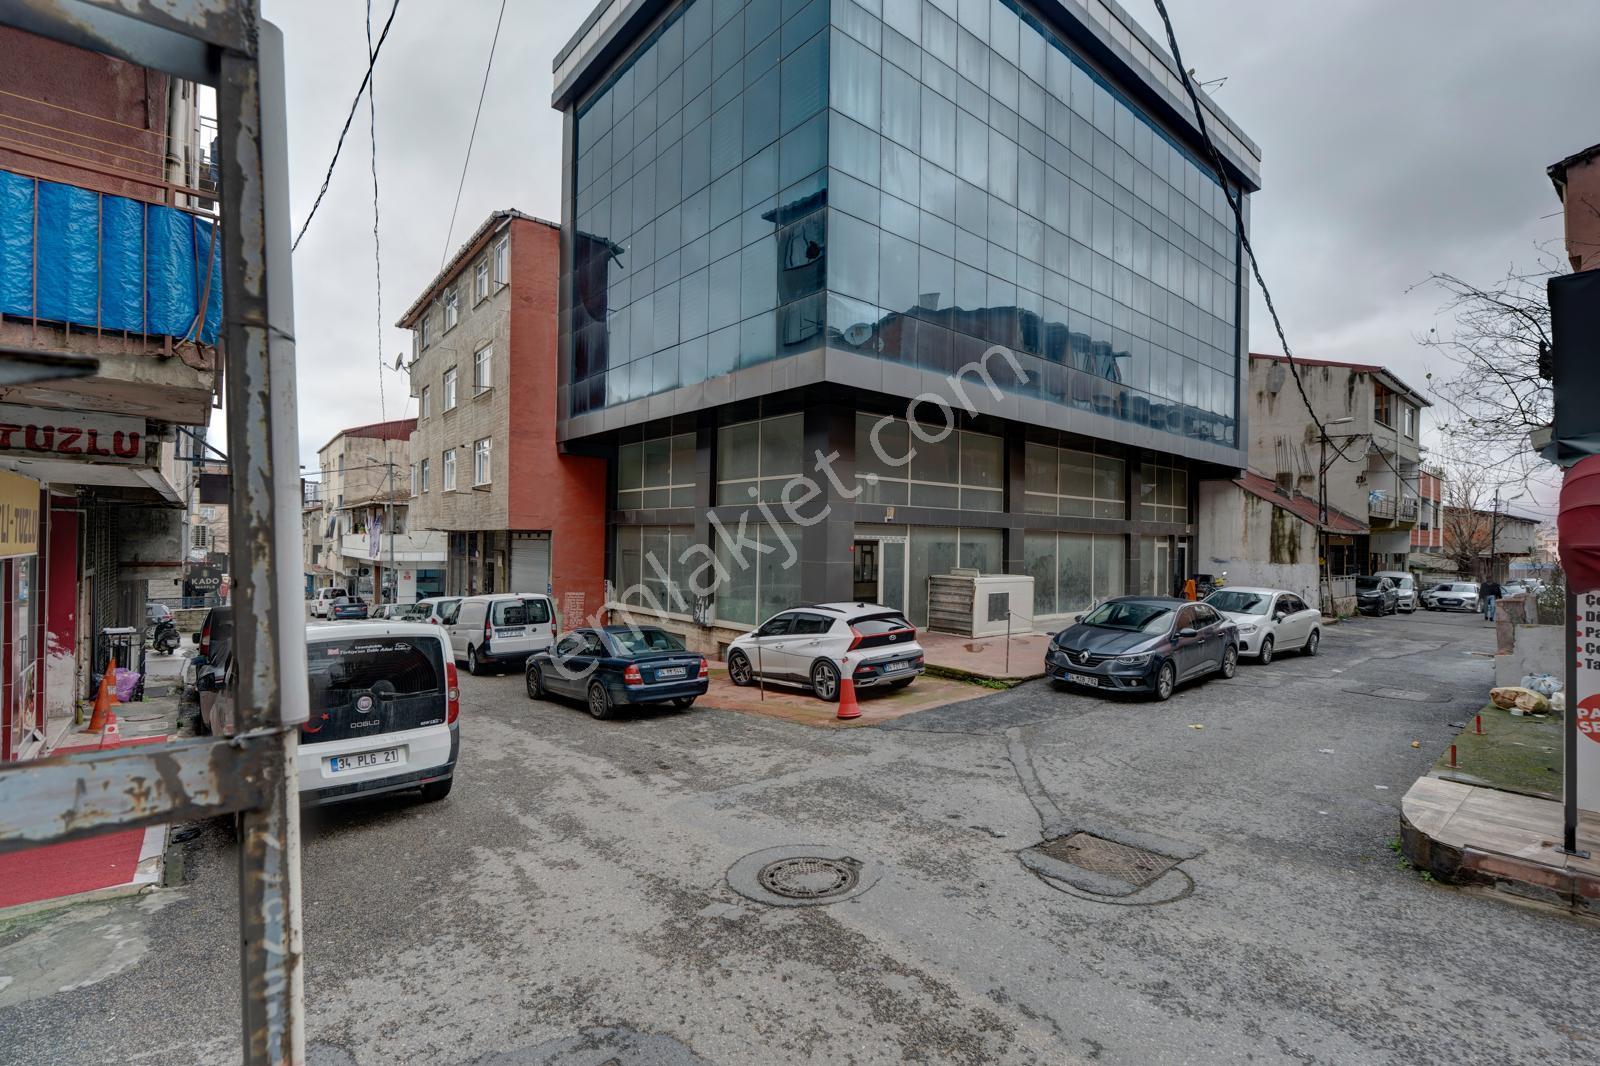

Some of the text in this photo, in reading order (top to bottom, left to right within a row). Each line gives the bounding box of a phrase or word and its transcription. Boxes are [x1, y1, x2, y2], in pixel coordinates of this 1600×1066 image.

[0, 423, 140, 458] TUZLU
[350, 720, 380, 728] DOBLO
[338, 750, 396, 769] 34 PLG 21
